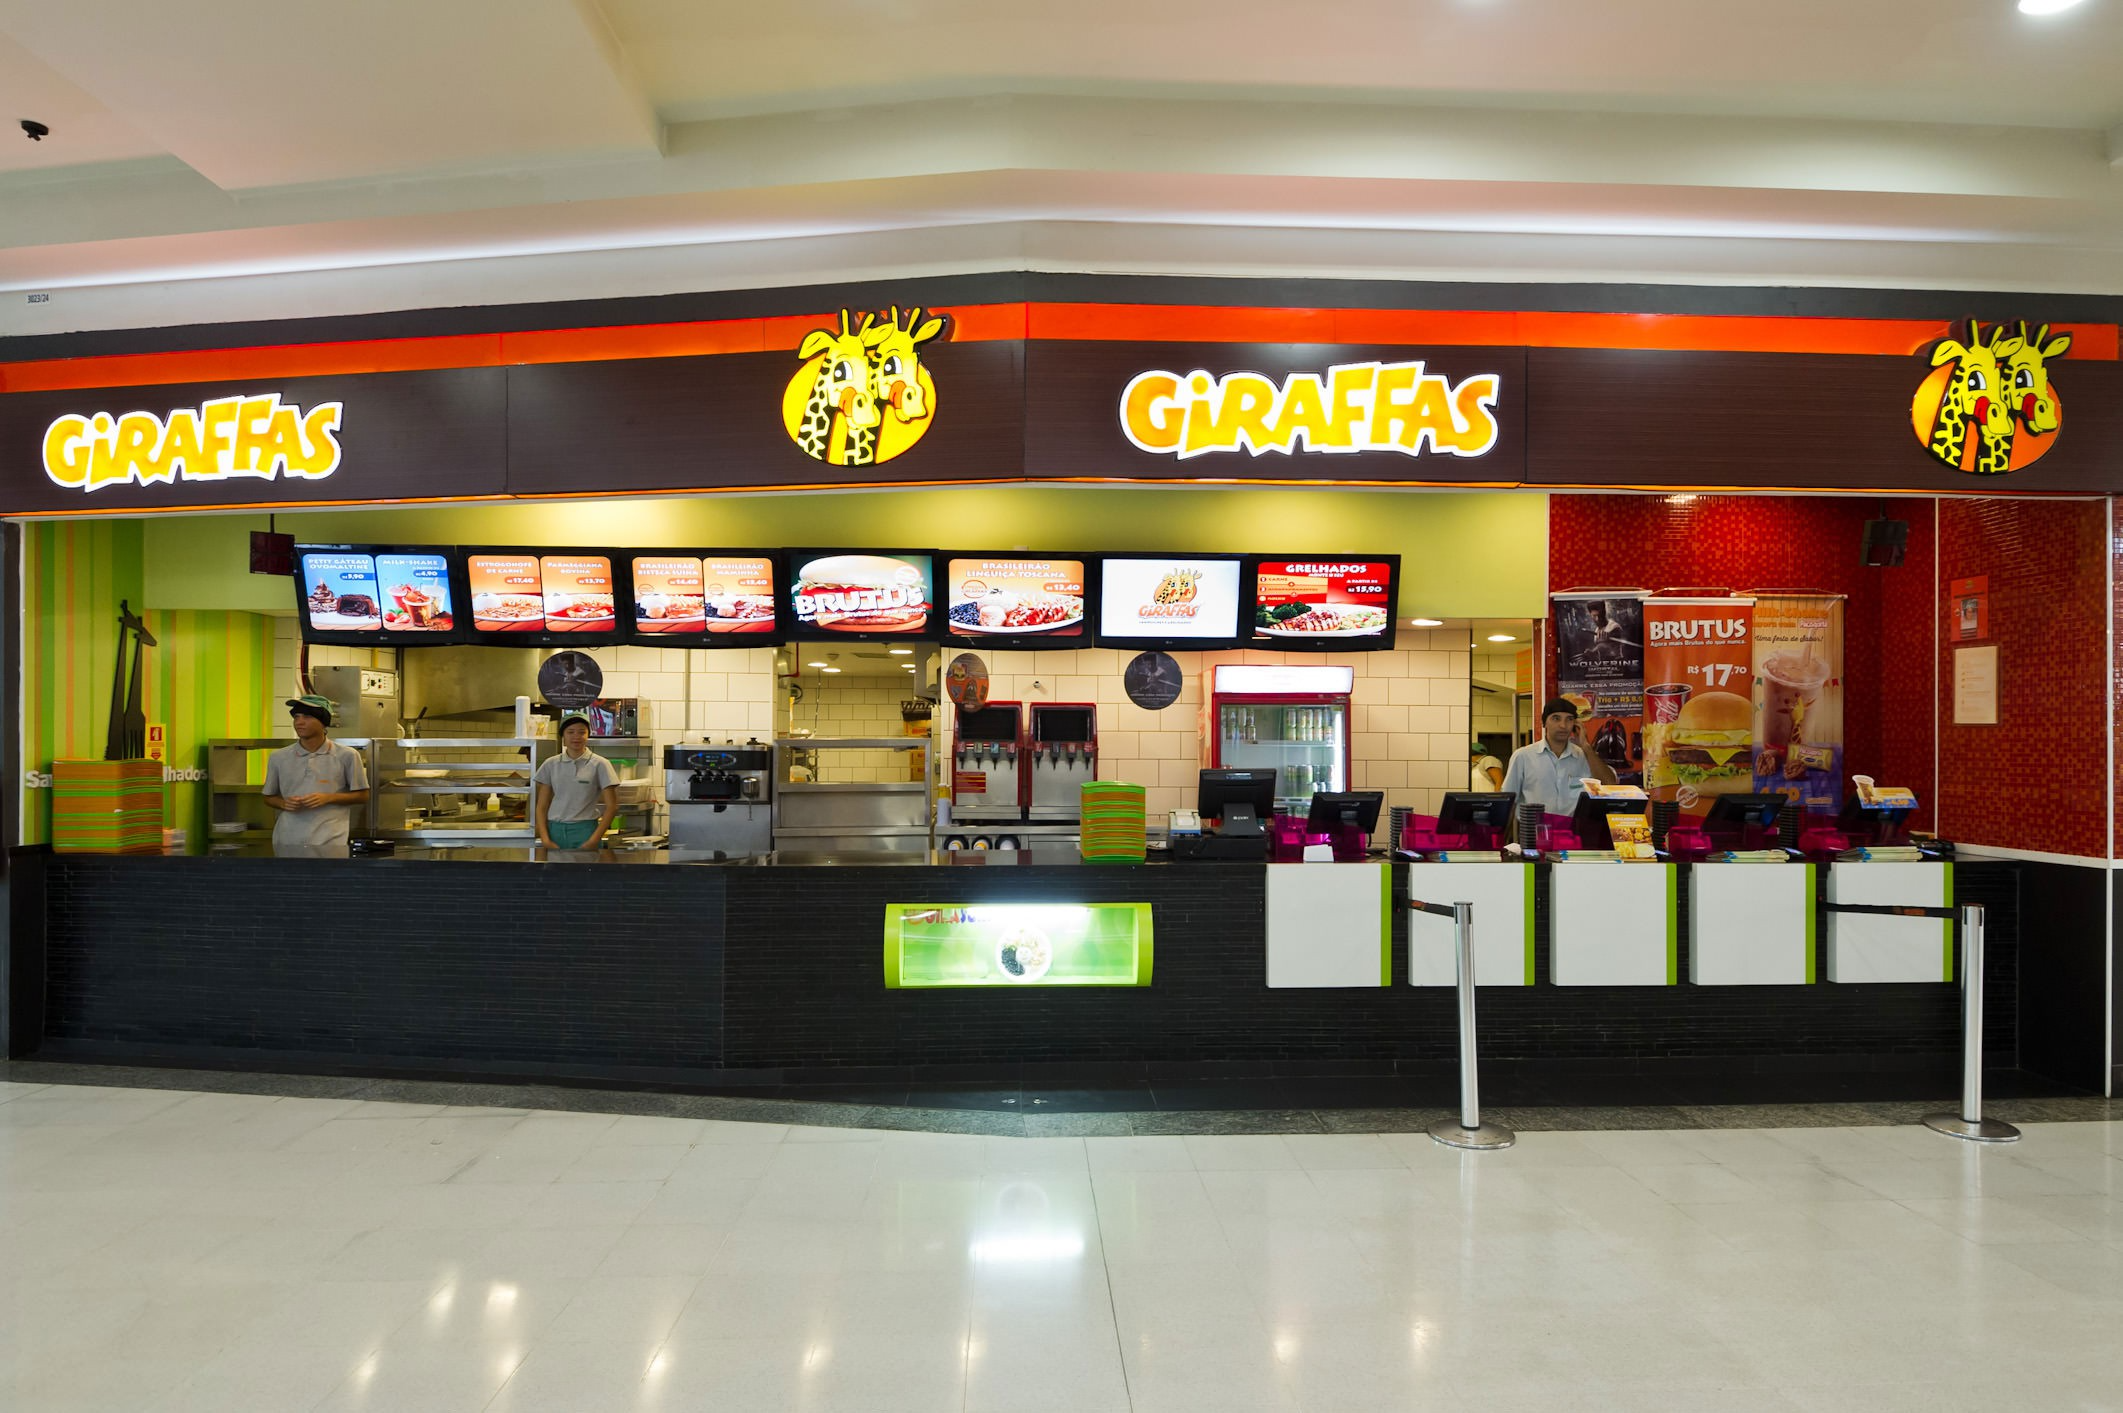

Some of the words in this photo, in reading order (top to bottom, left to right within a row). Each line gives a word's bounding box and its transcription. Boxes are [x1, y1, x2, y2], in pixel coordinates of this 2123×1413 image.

[982, 562, 1050, 570] BRASILEIRÃO
[1285, 564, 1367, 573] GRELHADOS
[966, 571, 1015, 579] LINGUIÇA
[1355, 586, 1382, 594] 15,90
[794, 586, 925, 614] BRUTUS
[1649, 619, 1747, 640] BRUTUS
[1650, 640, 1667, 648] Agora
[1688, 665, 1699, 675] R$
